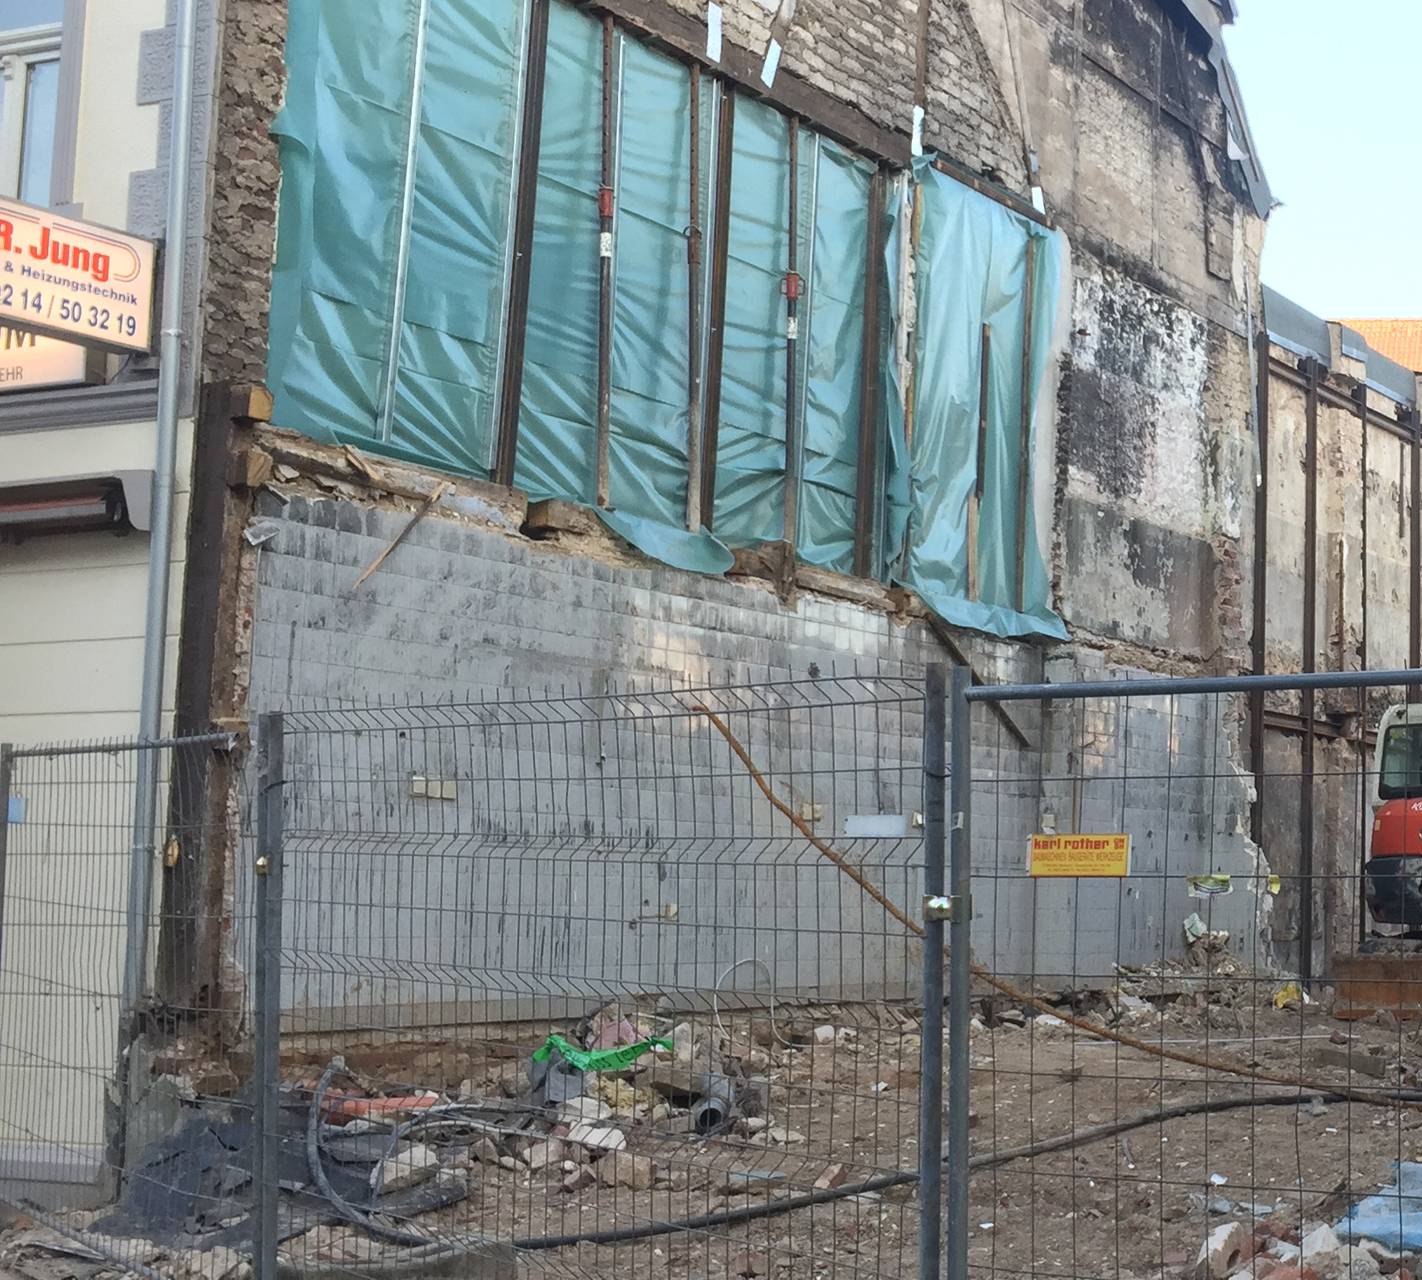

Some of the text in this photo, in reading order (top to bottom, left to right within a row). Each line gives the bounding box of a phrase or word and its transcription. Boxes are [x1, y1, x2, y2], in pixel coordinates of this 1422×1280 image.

[29, 226, 110, 282] Jung
[4, 260, 138, 305] & Heizungstechnik
[0, 283, 13, 306] 2
[21, 288, 42, 313] 14
[60, 298, 82, 323] 50
[88, 305, 110, 330] 32
[117, 313, 136, 336] 19
[1033, 838, 1110, 850] karl rother
